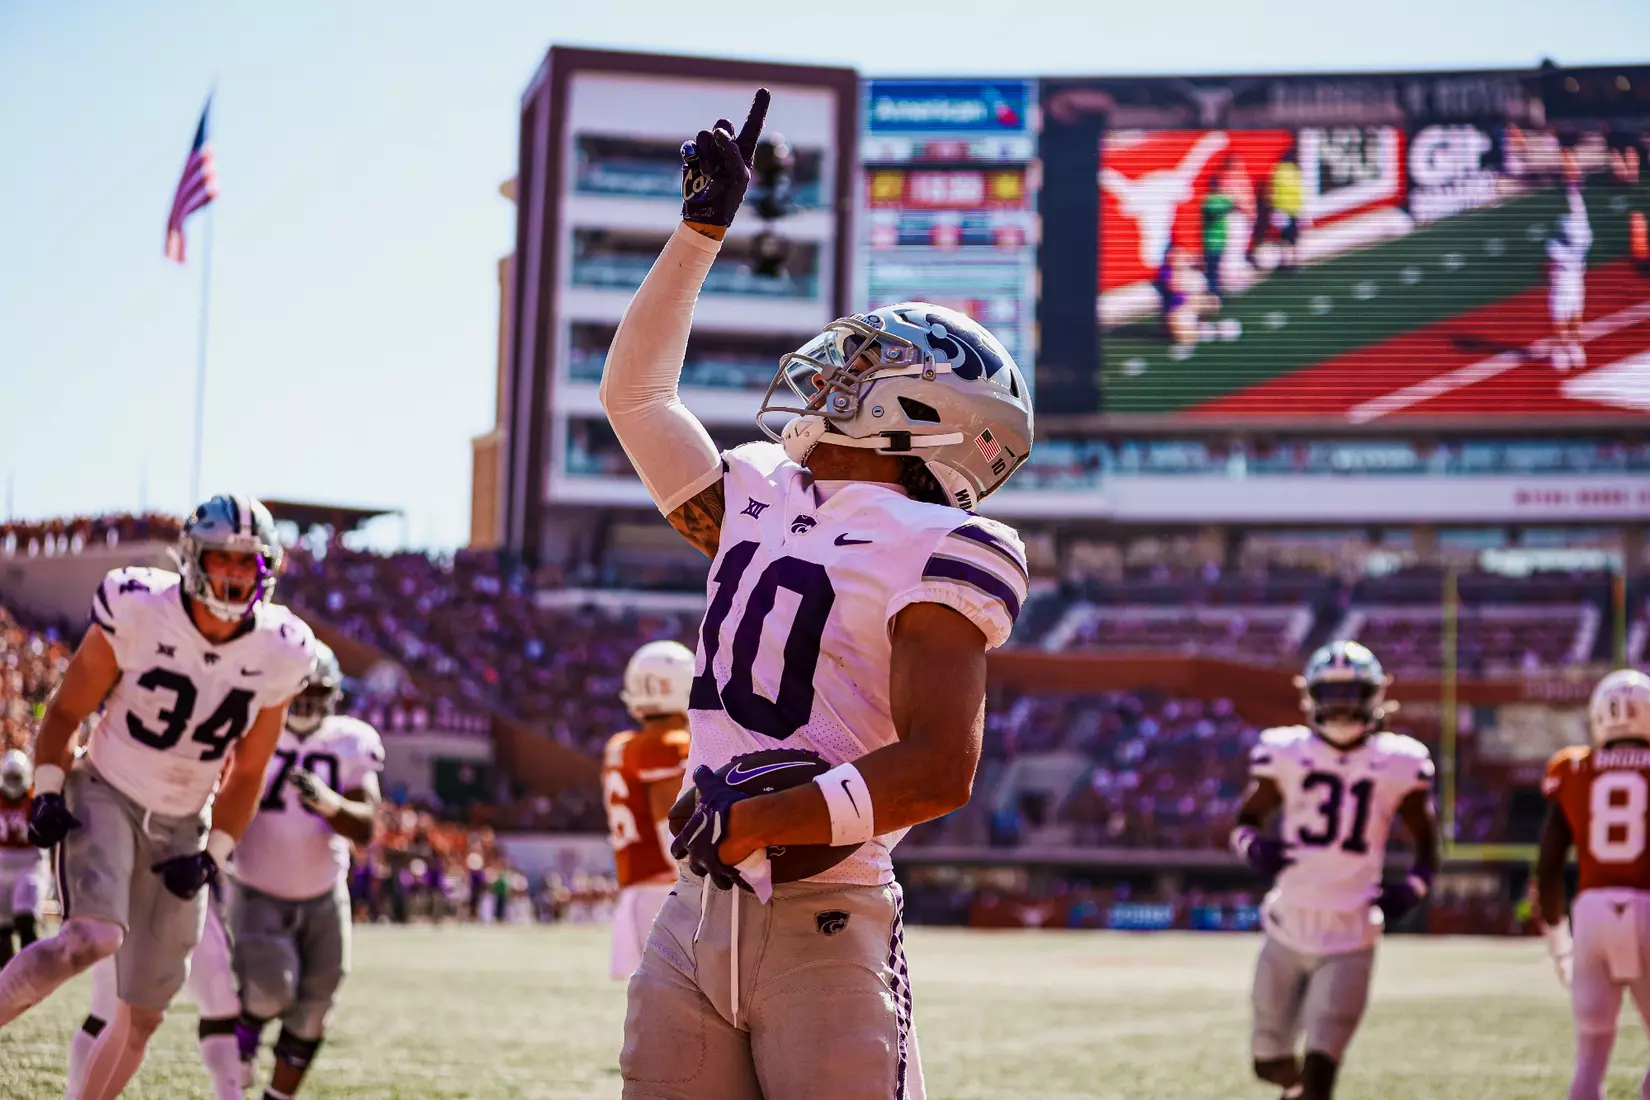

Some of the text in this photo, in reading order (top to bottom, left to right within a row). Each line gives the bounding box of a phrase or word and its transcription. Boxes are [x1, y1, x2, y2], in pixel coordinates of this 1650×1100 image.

[991, 457, 1006, 476] 10
[688, 540, 836, 740] 10
[126, 667, 256, 762] 34
[260, 748, 339, 817] 70
[1298, 771, 1373, 853] 31
[1589, 771, 1648, 863] 8
